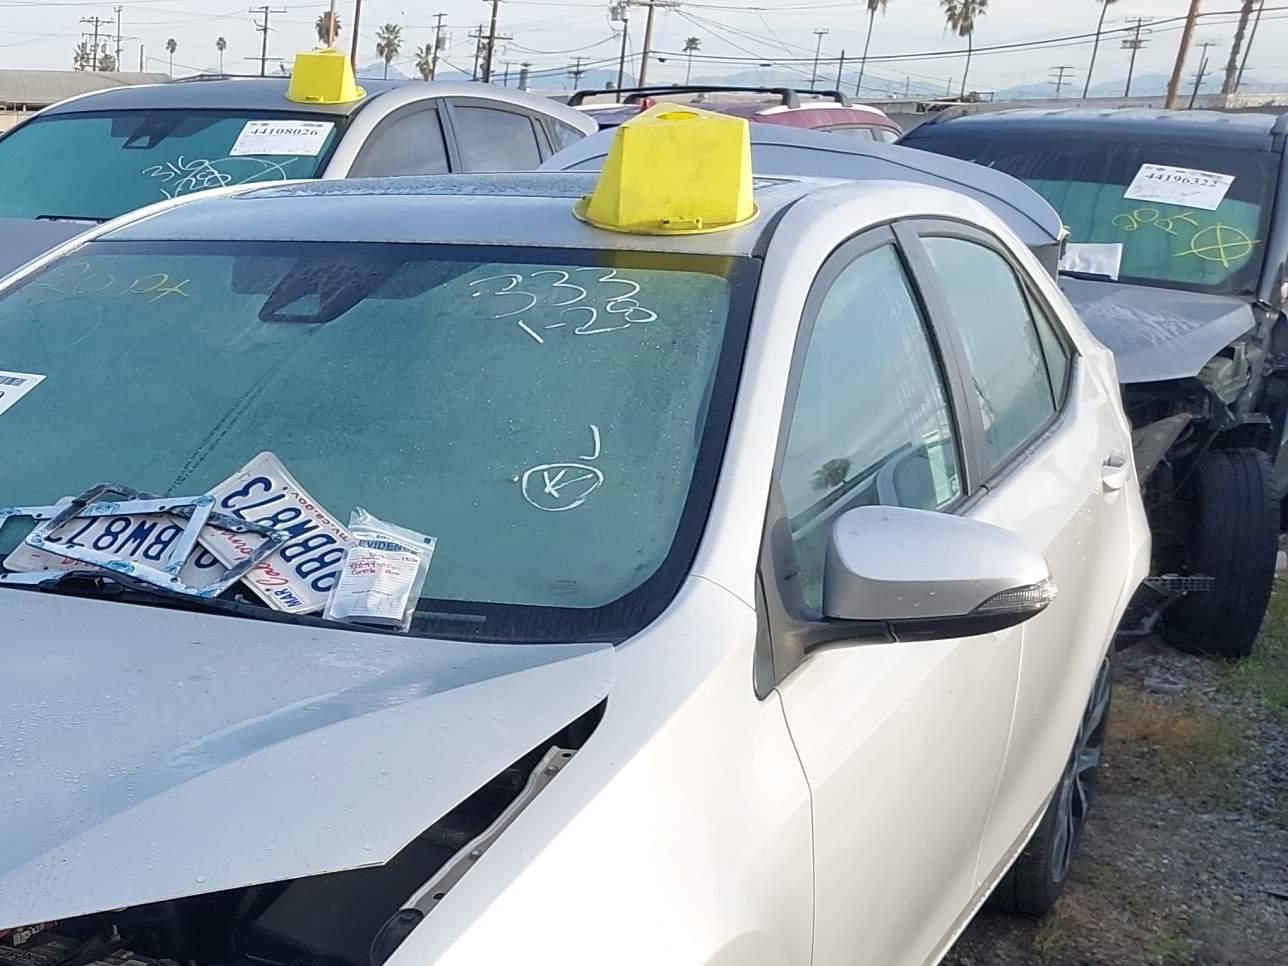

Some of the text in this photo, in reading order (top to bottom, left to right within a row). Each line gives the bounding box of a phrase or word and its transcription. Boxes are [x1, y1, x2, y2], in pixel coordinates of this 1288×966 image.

[250, 127, 319, 137] 44108026
[1144, 172, 1219, 188] 44196322
[291, 491, 350, 542] mv.ca.gov
[272, 586, 303, 609] MAR
